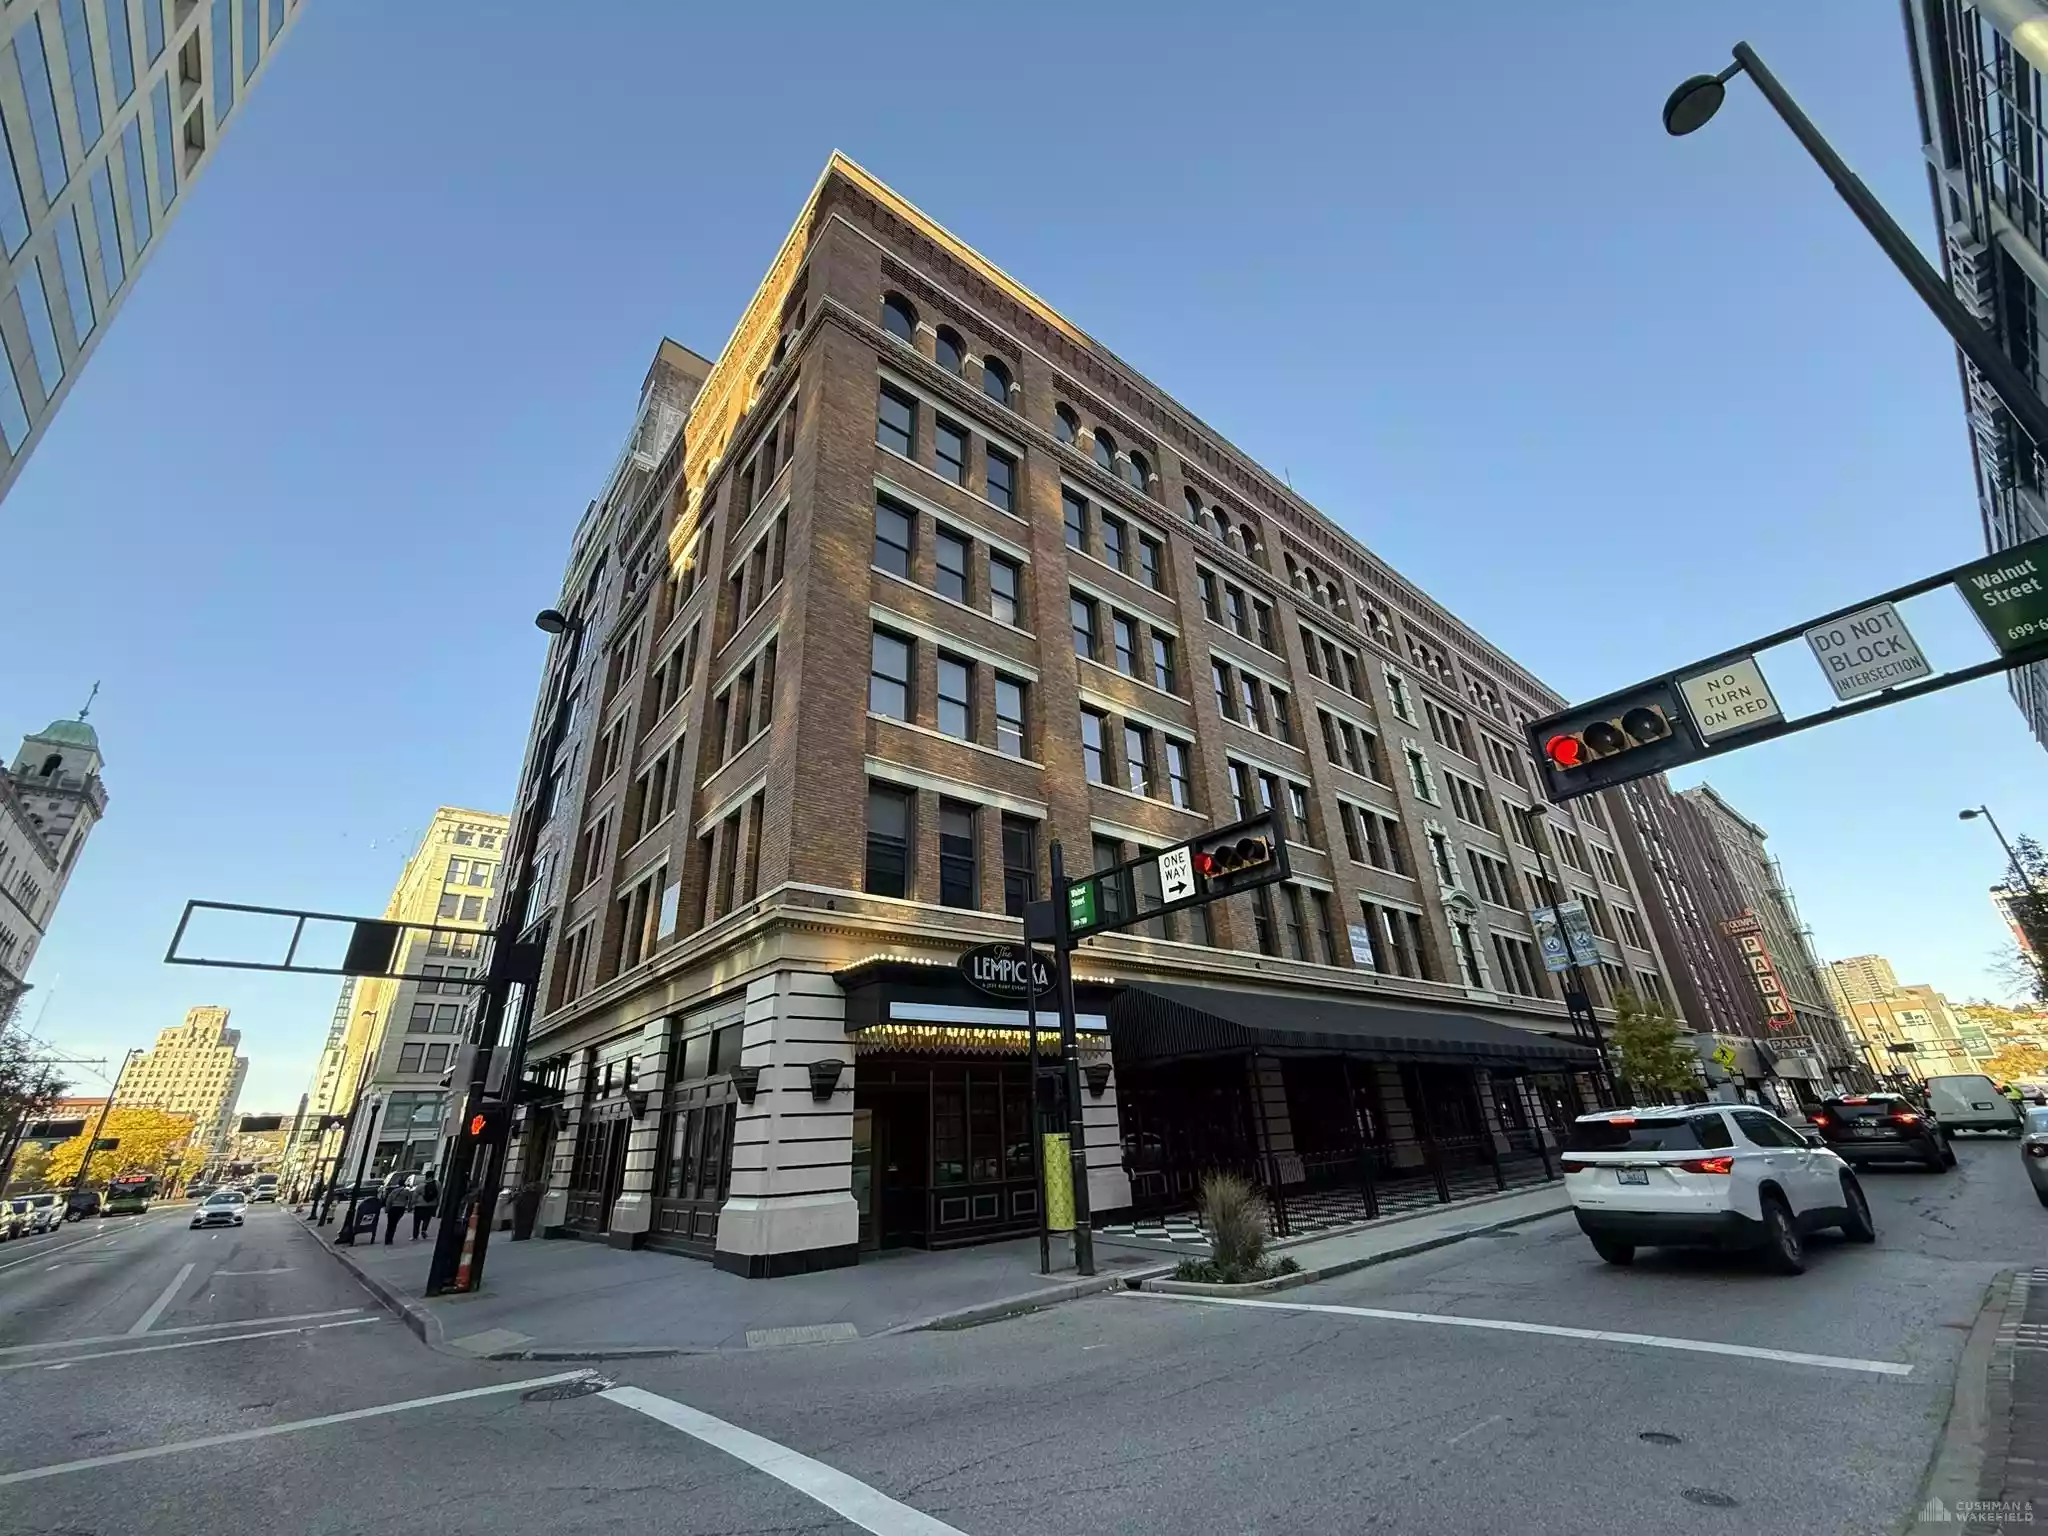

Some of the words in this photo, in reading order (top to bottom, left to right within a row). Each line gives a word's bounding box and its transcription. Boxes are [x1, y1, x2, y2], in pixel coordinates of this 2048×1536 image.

[1970, 559, 2038, 590] Walnut
[1982, 577, 2043, 607] Street
[1814, 629, 1846, 652] DO
[1849, 611, 1893, 640] NOT
[2007, 617, 2048, 640] 699-6
[1827, 634, 1907, 673] BLOCK
[1706, 674, 1736, 692] NO
[1836, 655, 1921, 692] INTERSECTION
[1705, 685, 1752, 708] TURN
[1703, 710, 1728, 726] ON
[1732, 698, 1768, 717] RED
[1163, 851, 1185, 868] ONE
[1164, 863, 1187, 881] WAY
[993, 944, 1013, 960] The
[1743, 938, 1785, 1013] PARK
[1771, 1036, 1810, 1050] PARK
